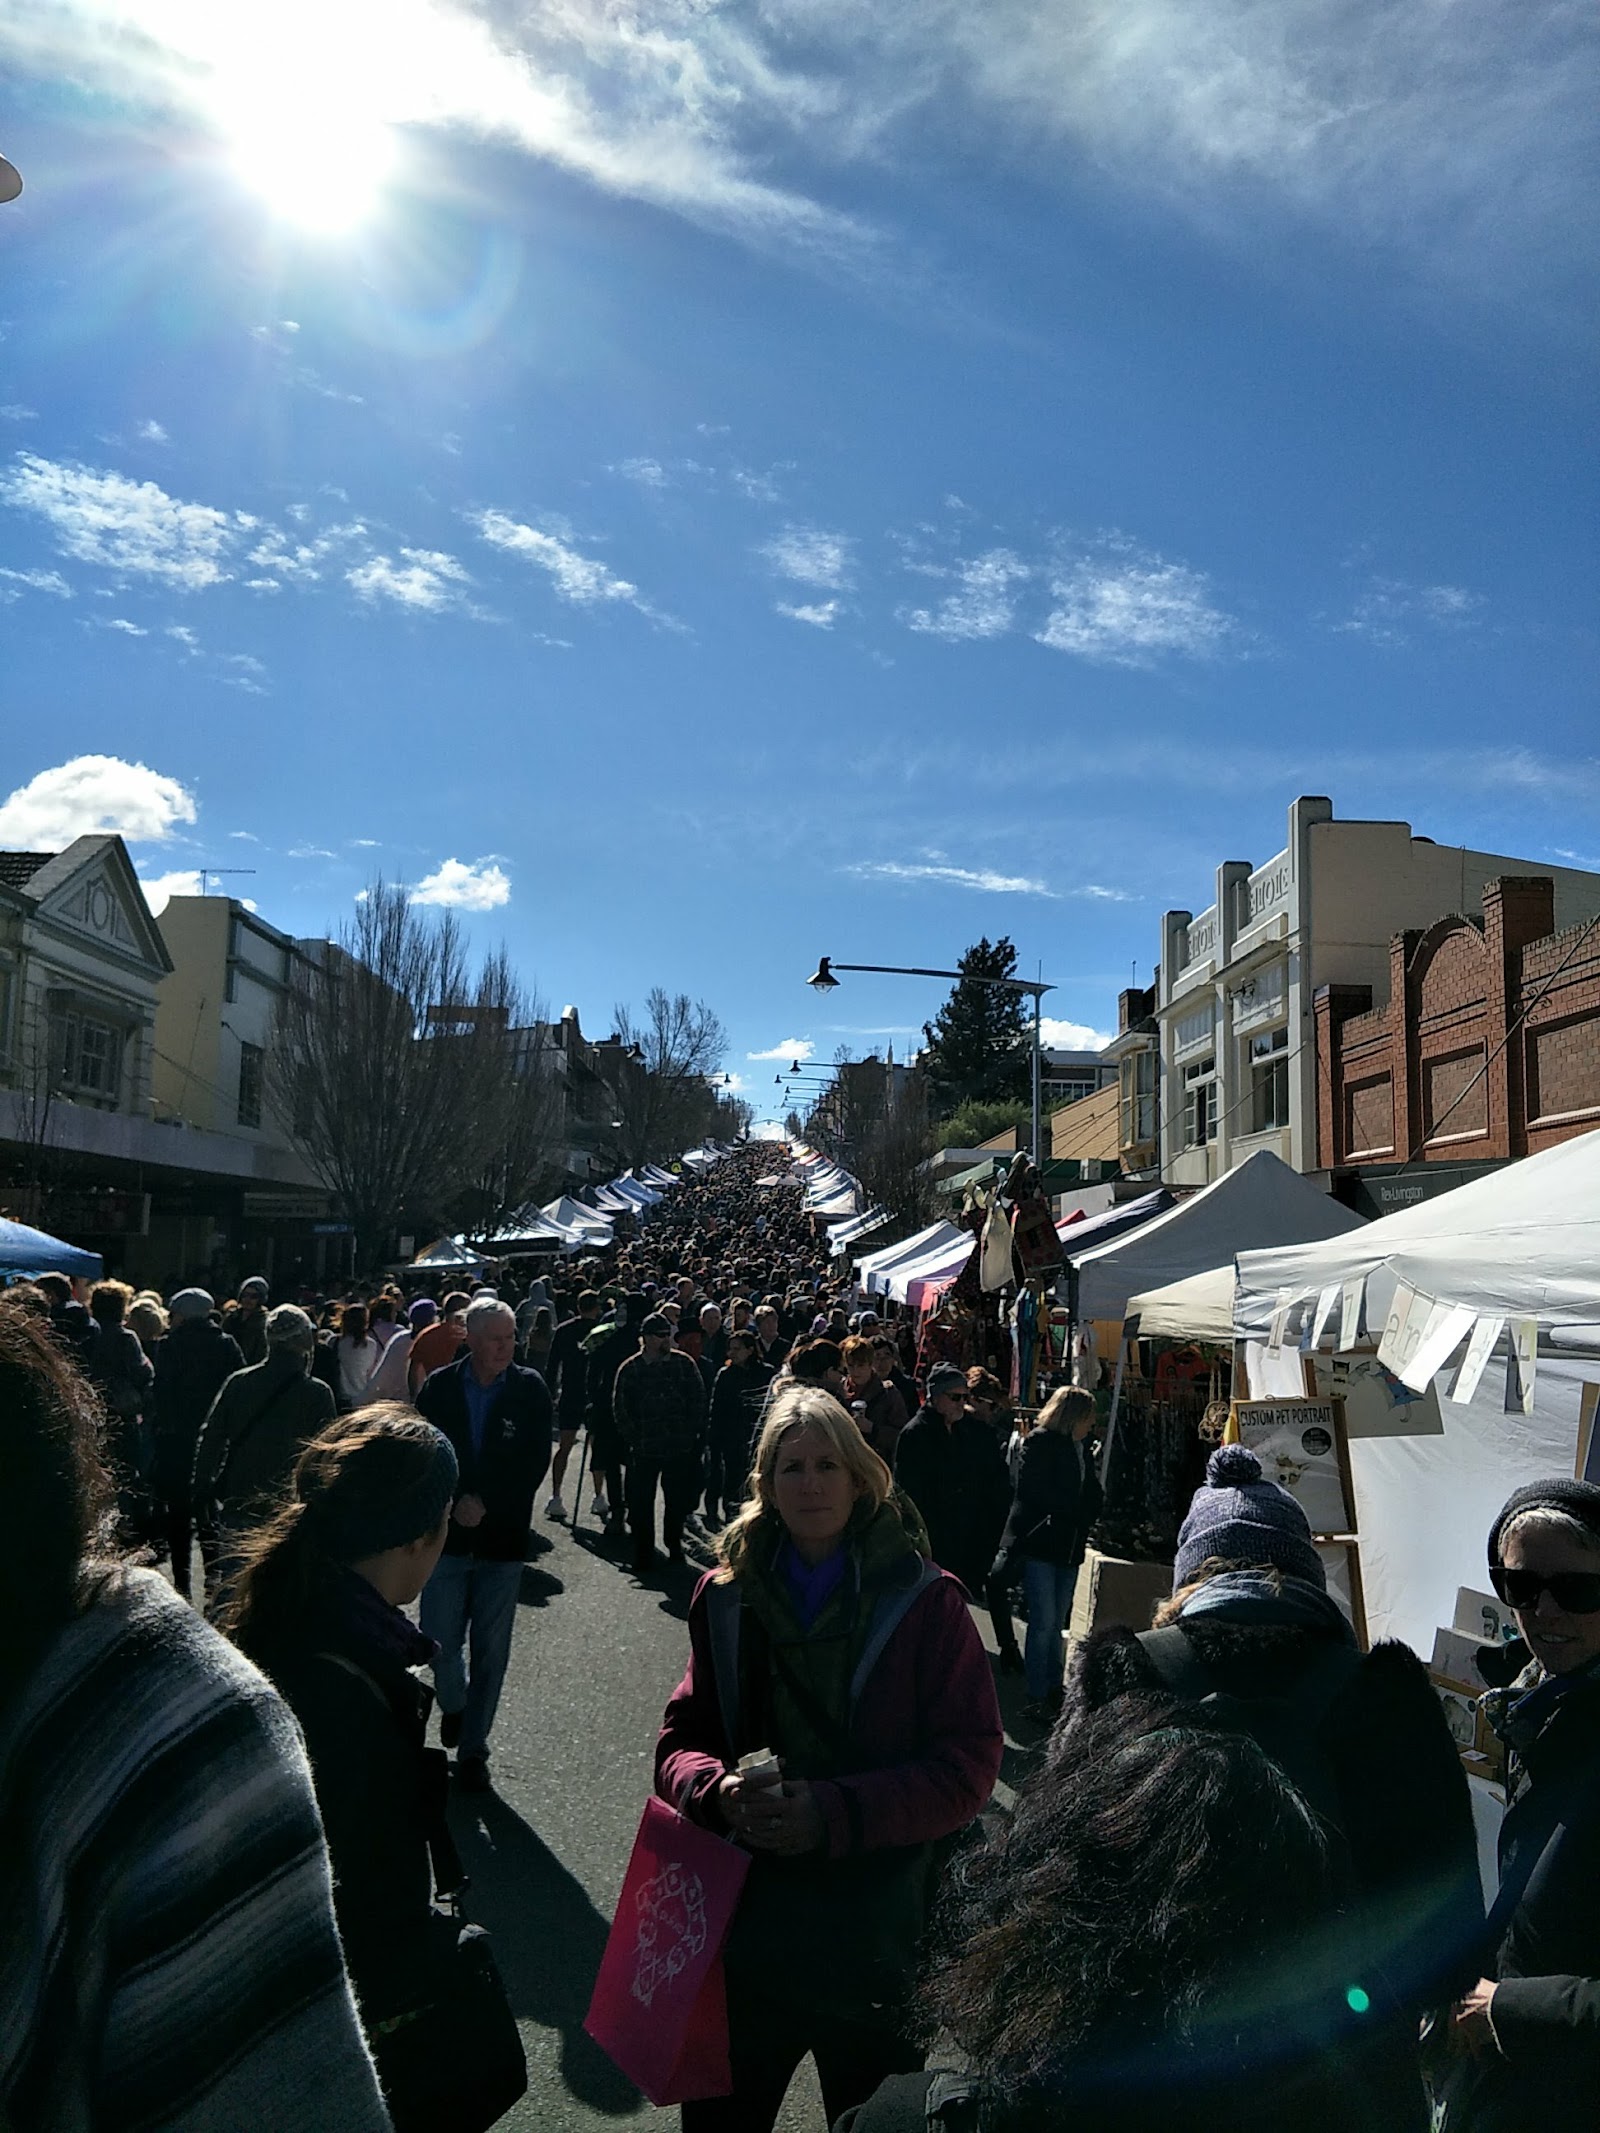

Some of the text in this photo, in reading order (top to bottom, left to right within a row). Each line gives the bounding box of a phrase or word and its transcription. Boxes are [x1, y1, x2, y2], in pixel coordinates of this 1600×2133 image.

[1240, 1406, 1331, 1427] CUSTOM PET PORTRAIT
